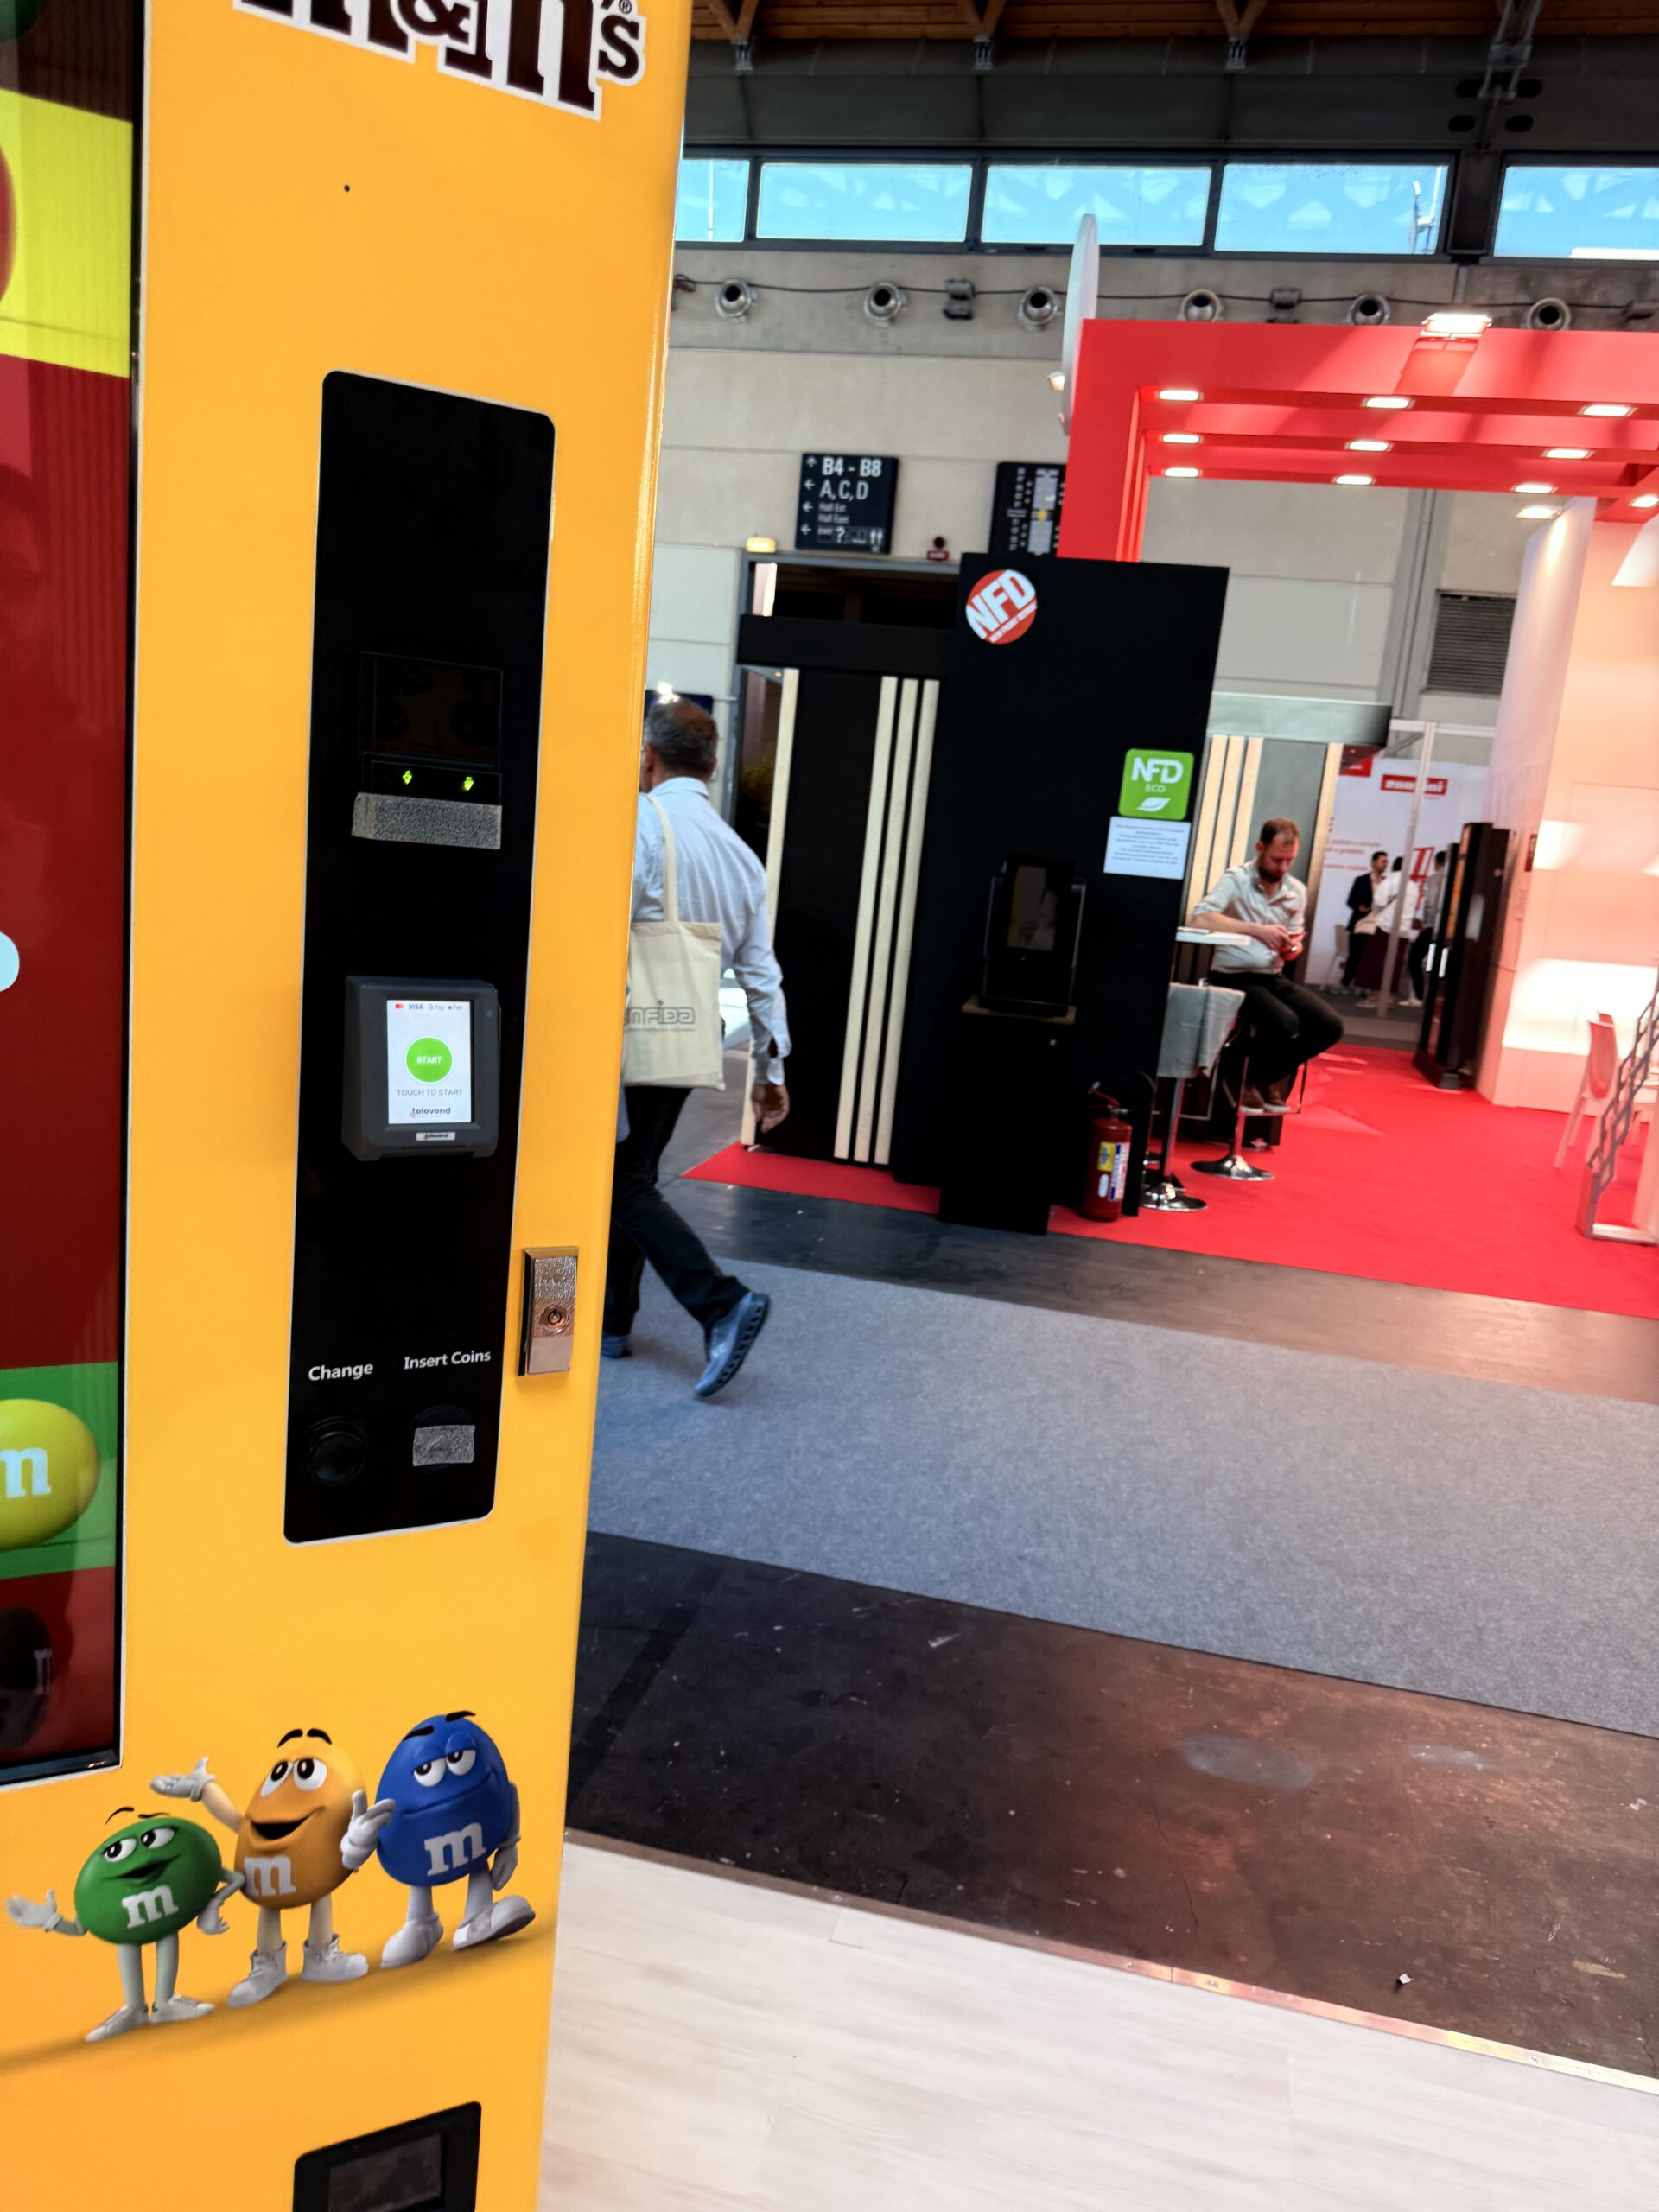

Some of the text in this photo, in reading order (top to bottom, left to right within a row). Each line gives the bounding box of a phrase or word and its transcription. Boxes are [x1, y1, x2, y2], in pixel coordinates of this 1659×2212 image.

[822, 456, 844, 476] B4
[859, 458, 882, 477] B8
[966, 569, 1036, 639] NFD
[1131, 757, 1184, 784] NFD
[1145, 784, 1166, 793] ECO
[416, 1056, 442, 1065] START
[308, 1363, 374, 1381] Change
[404, 1350, 492, 1370] Insert Coins
[423, 1821, 486, 1877] m
[243, 1855, 296, 1897] m
[122, 1885, 179, 1929] m
